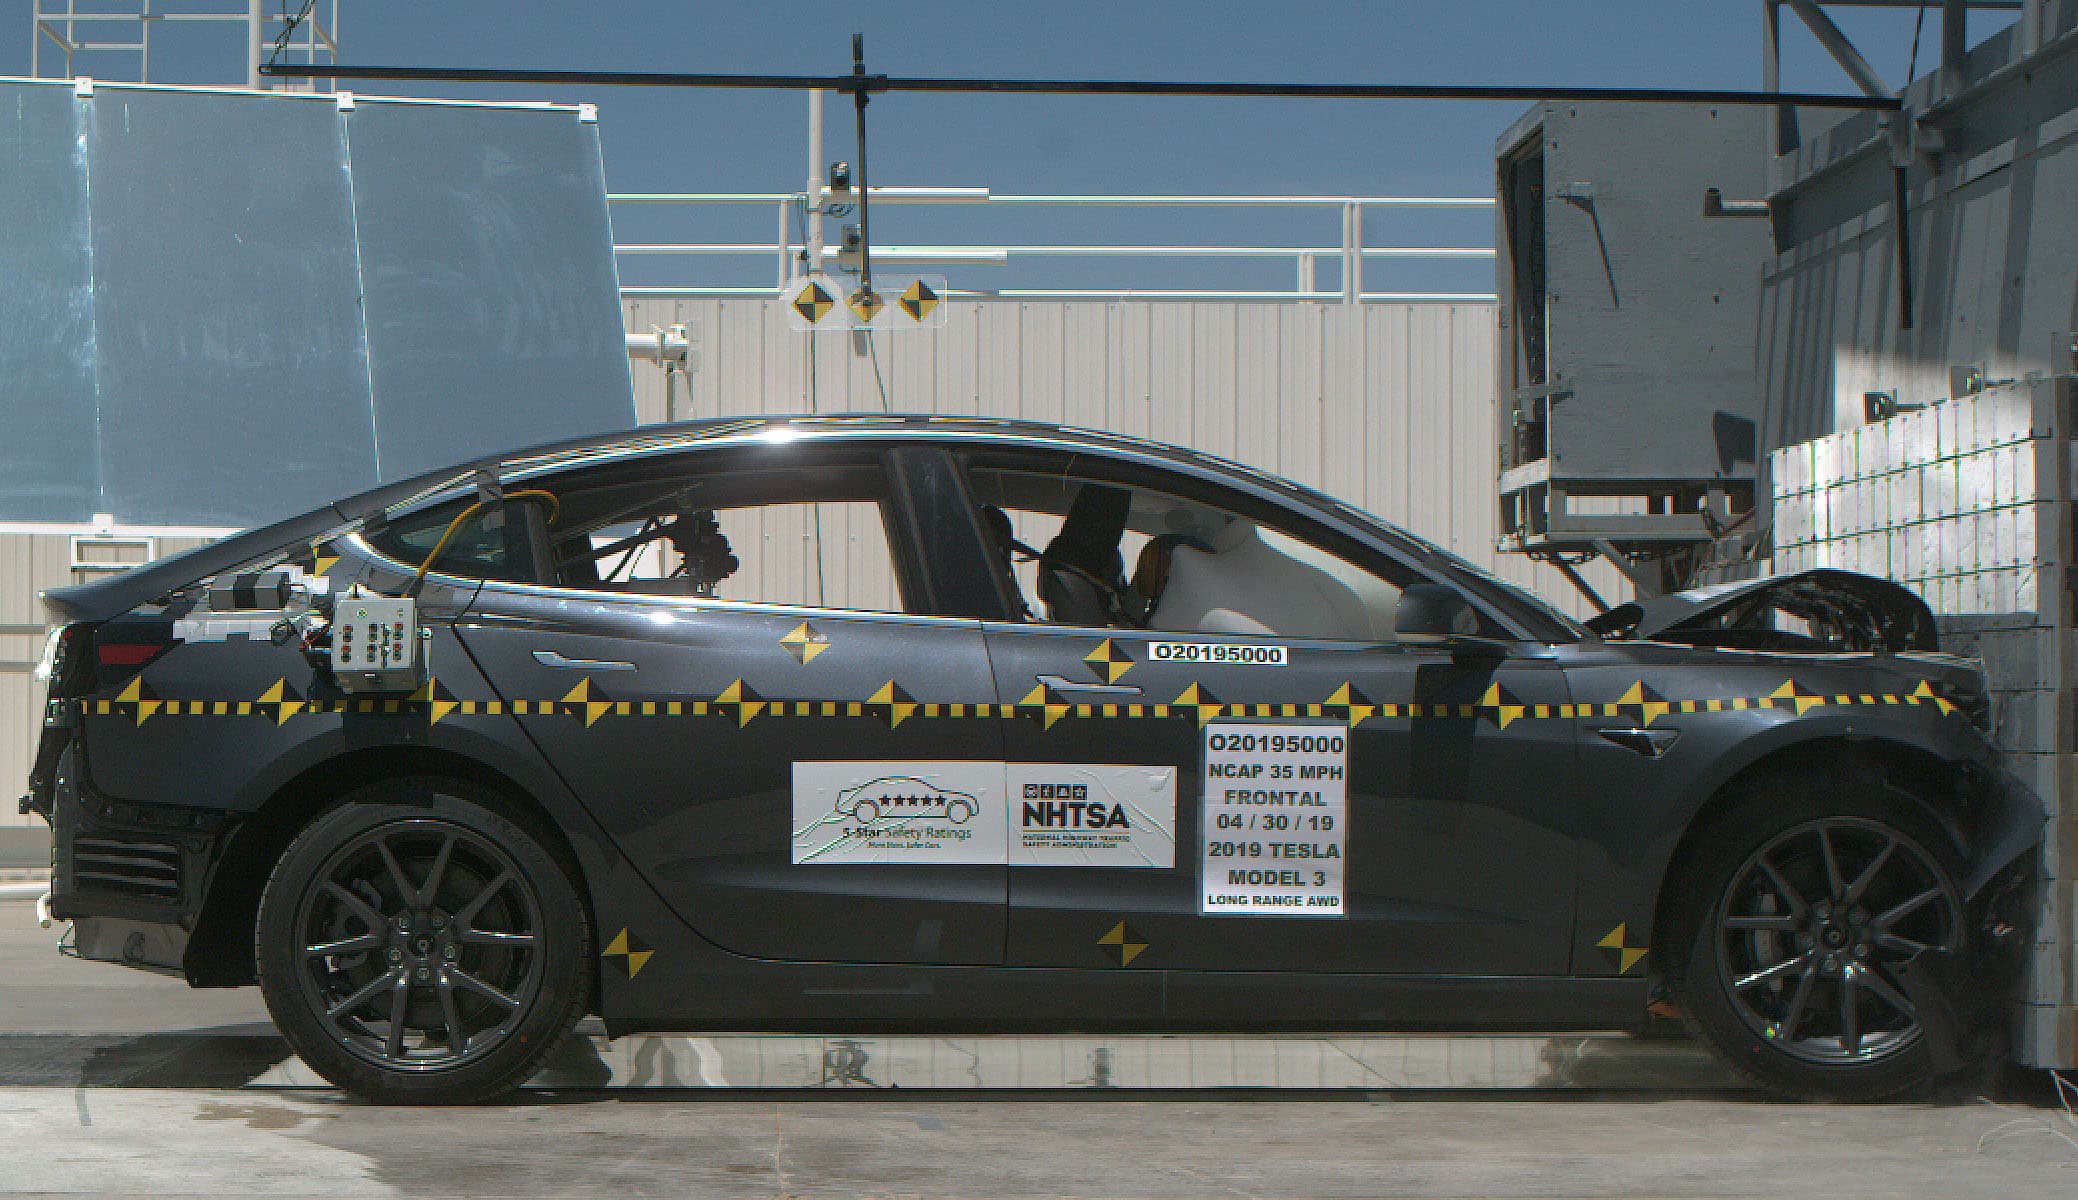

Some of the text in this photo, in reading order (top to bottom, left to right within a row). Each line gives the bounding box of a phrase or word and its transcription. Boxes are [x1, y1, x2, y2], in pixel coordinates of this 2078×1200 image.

[1208, 763, 1344, 780] NCAP 35 MPH
[1224, 790, 1328, 806] FRONTAL
[1022, 801, 1130, 828] NHTSA
[1216, 814, 1243, 830] 04
[1262, 814, 1289, 830] 30
[1308, 815, 1334, 831] 19
[926, 826, 972, 841] Ratings
[1209, 841, 1341, 858] 2019 TESLA
[1228, 869, 1326, 886] MODEL 3
[1207, 895, 1340, 906] LONG RANGE AWD
